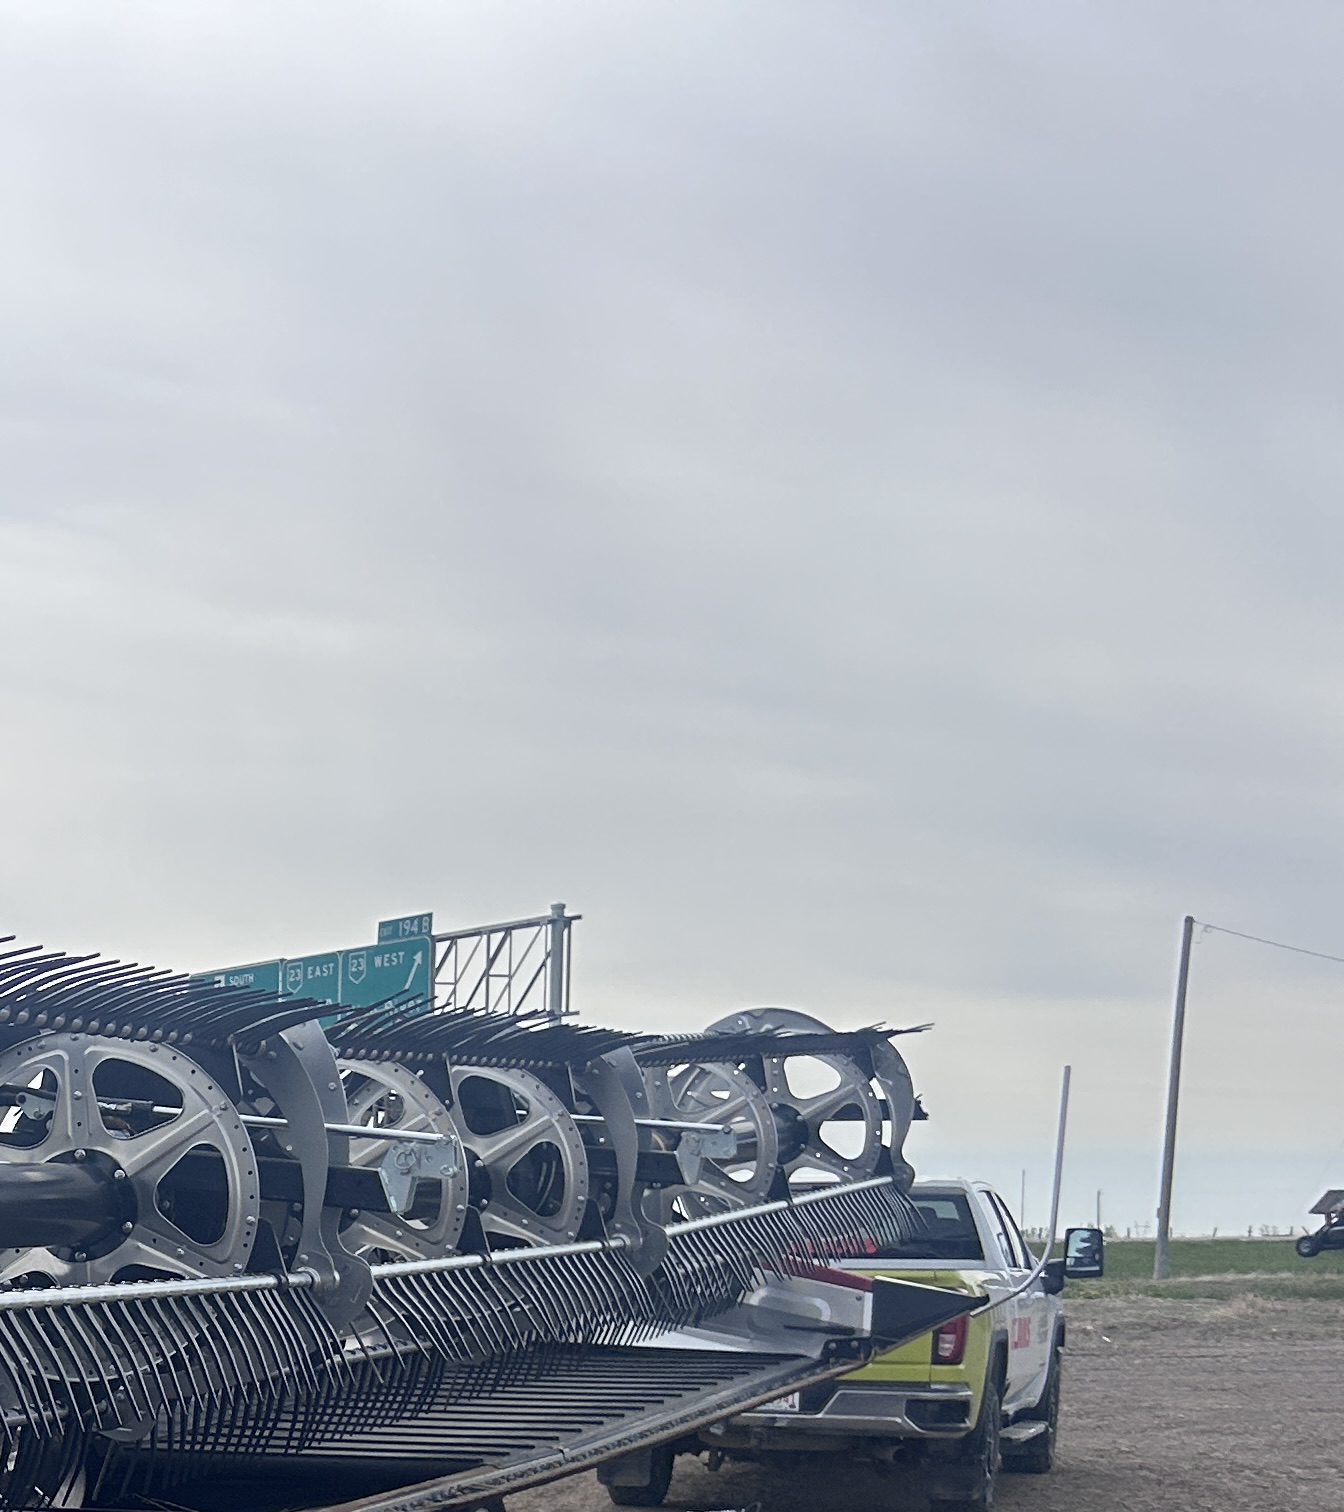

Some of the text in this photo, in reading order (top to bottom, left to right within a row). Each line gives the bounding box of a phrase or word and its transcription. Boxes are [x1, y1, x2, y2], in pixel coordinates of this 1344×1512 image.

[399, 918, 419, 937] 194
[351, 951, 405, 972] 23 WEST
[229, 973, 254, 987] SOUTH
[288, 963, 335, 982] 23 EAST
